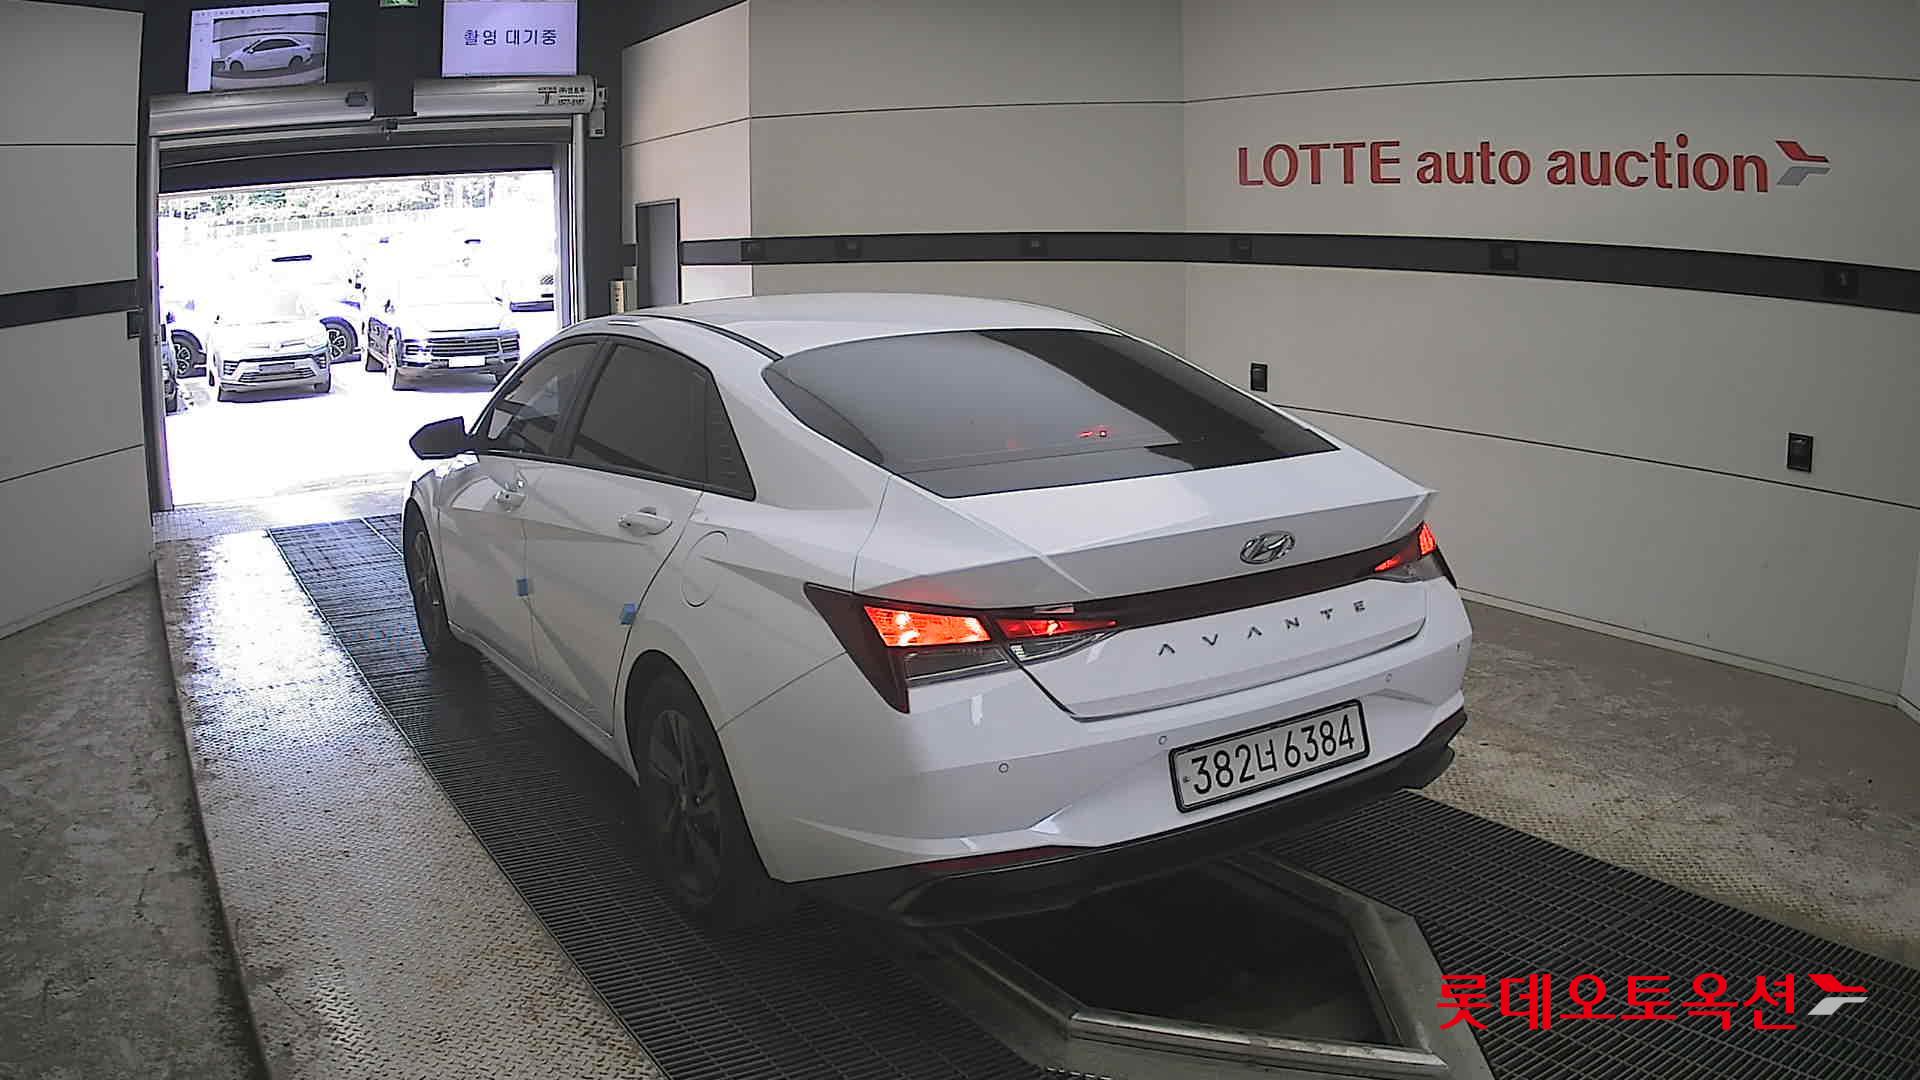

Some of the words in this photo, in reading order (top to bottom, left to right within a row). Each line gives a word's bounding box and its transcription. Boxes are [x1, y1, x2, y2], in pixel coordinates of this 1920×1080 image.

[464, 29, 497, 46] 촬영
[504, 29, 557, 46] 대기중
[1237, 142, 1401, 189] LOTTE
[1416, 142, 1533, 187] auto
[1545, 134, 1771, 193] auction
[1158, 600, 1366, 657] AVANTE
